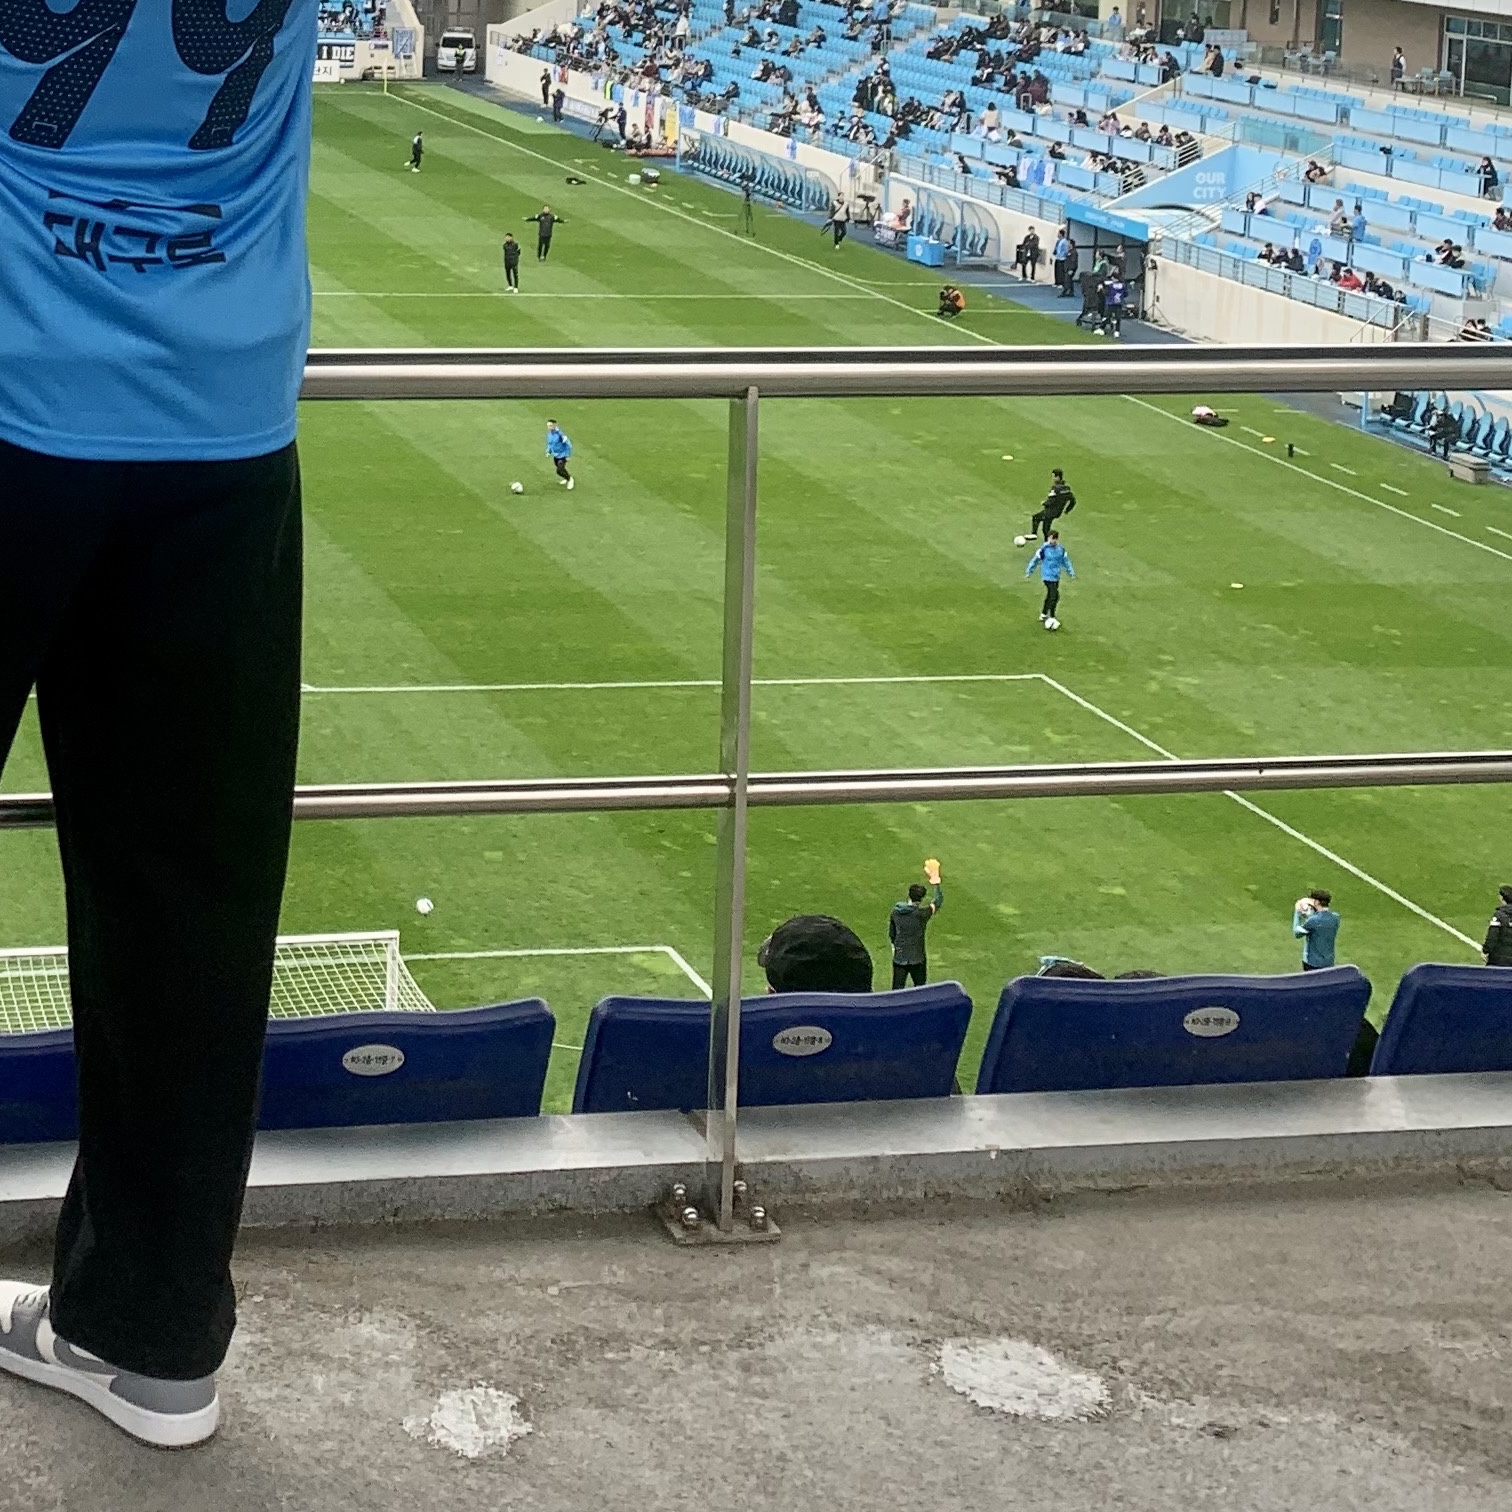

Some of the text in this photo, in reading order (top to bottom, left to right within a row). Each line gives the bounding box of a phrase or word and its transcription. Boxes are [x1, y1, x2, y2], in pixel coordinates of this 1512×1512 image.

[332, 46, 355, 60] DIE
[1195, 172, 1226, 185] OUR
[1193, 186, 1227, 199] CITY
